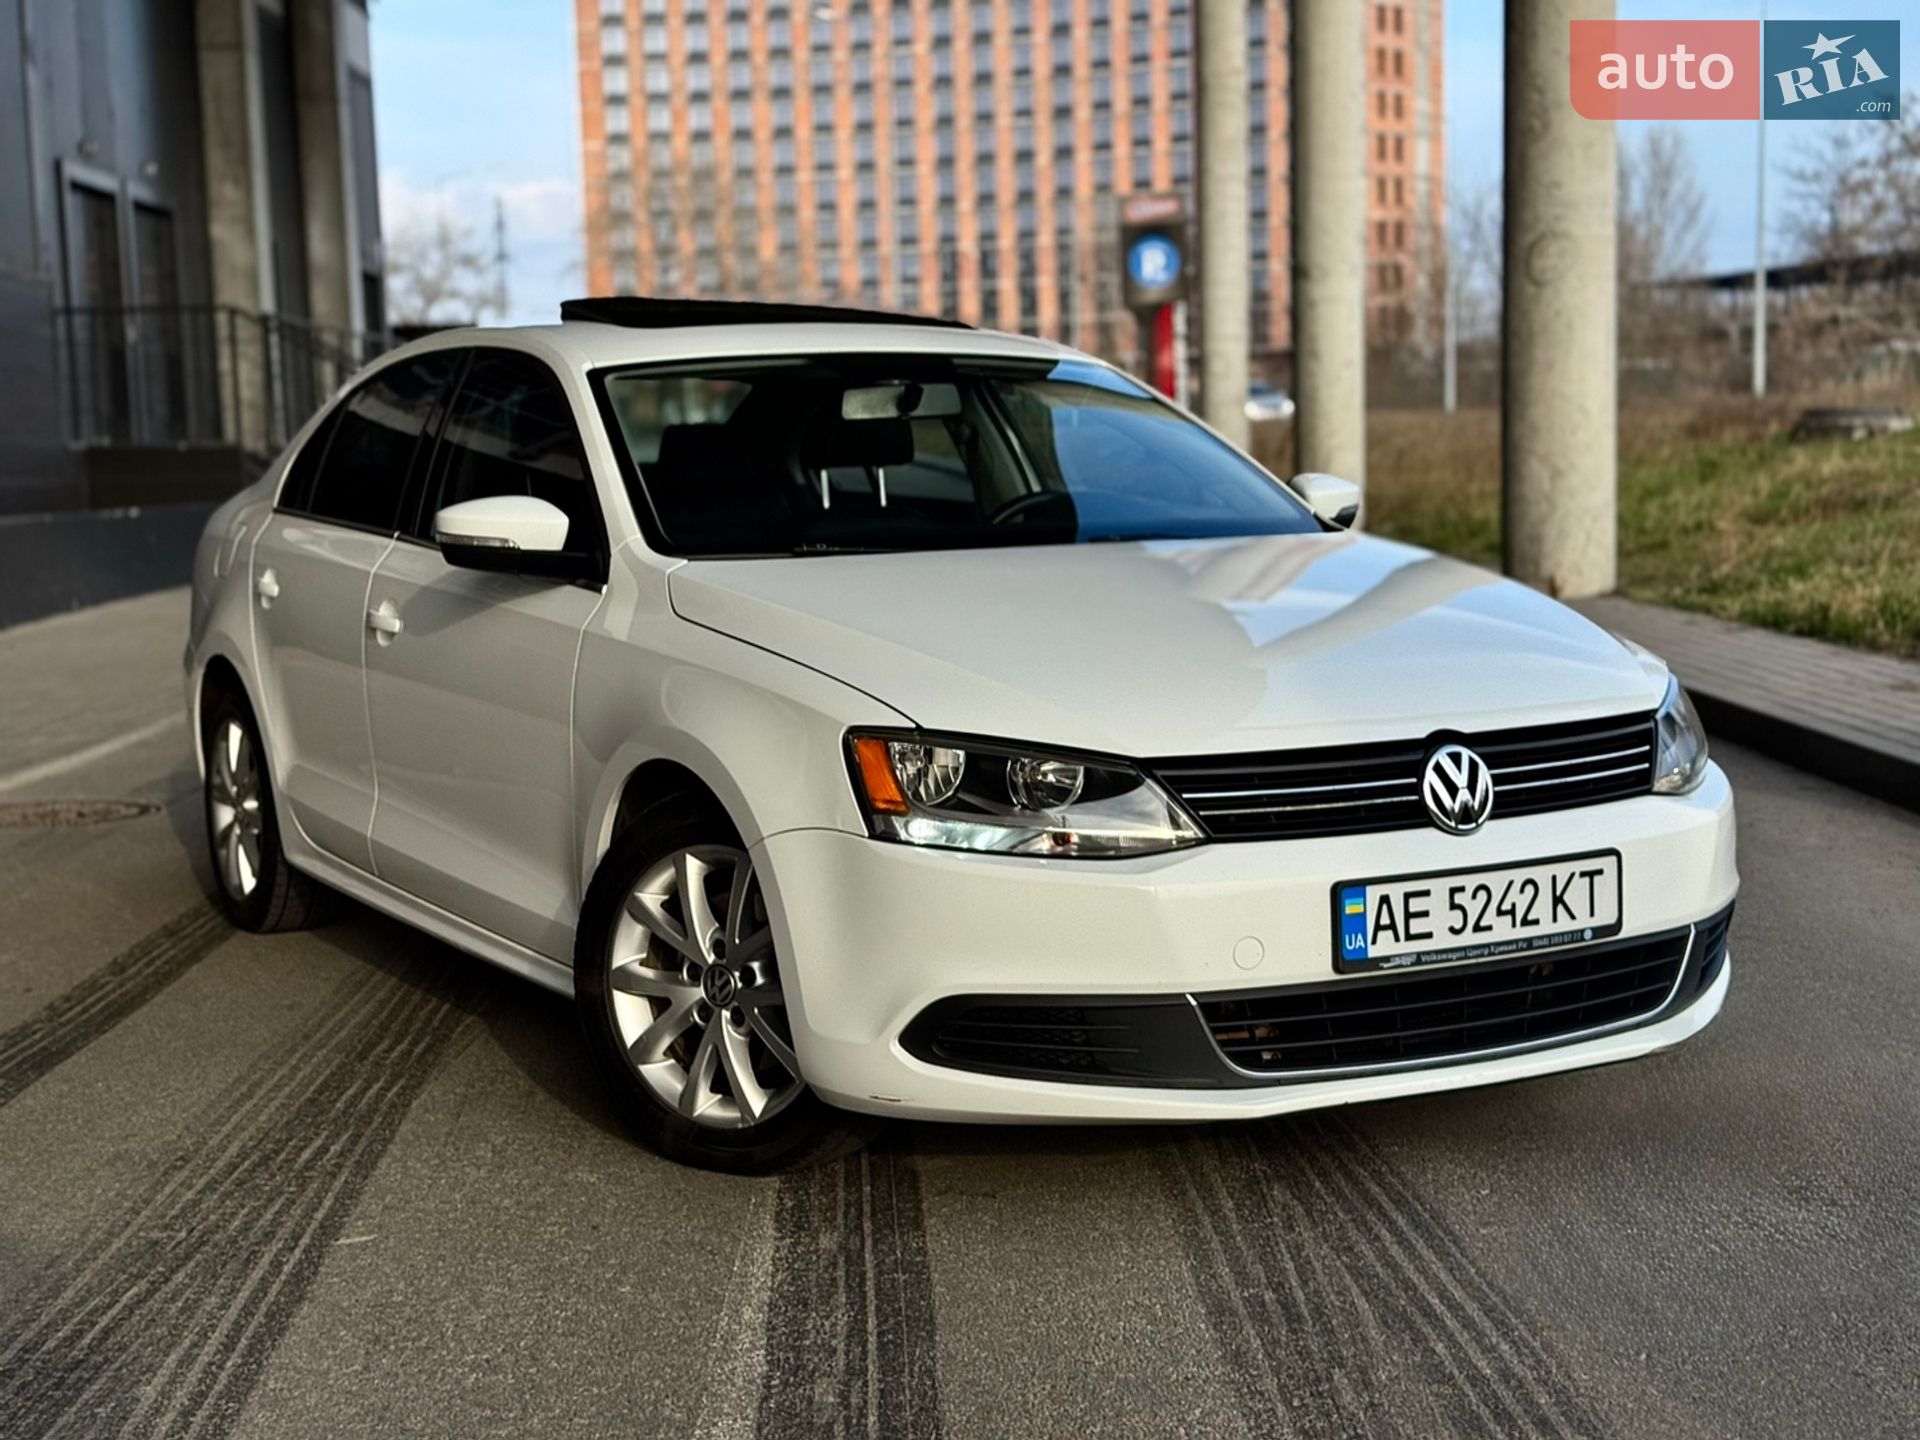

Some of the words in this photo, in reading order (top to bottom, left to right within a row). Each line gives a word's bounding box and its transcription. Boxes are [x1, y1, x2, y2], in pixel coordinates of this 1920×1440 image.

[1370, 889, 1433, 946] AE
[1448, 877, 1540, 936] 5242
[1551, 868, 1604, 924] KT
[1345, 933, 1366, 950] UA
[1420, 949, 1466, 963] Volkswagen
